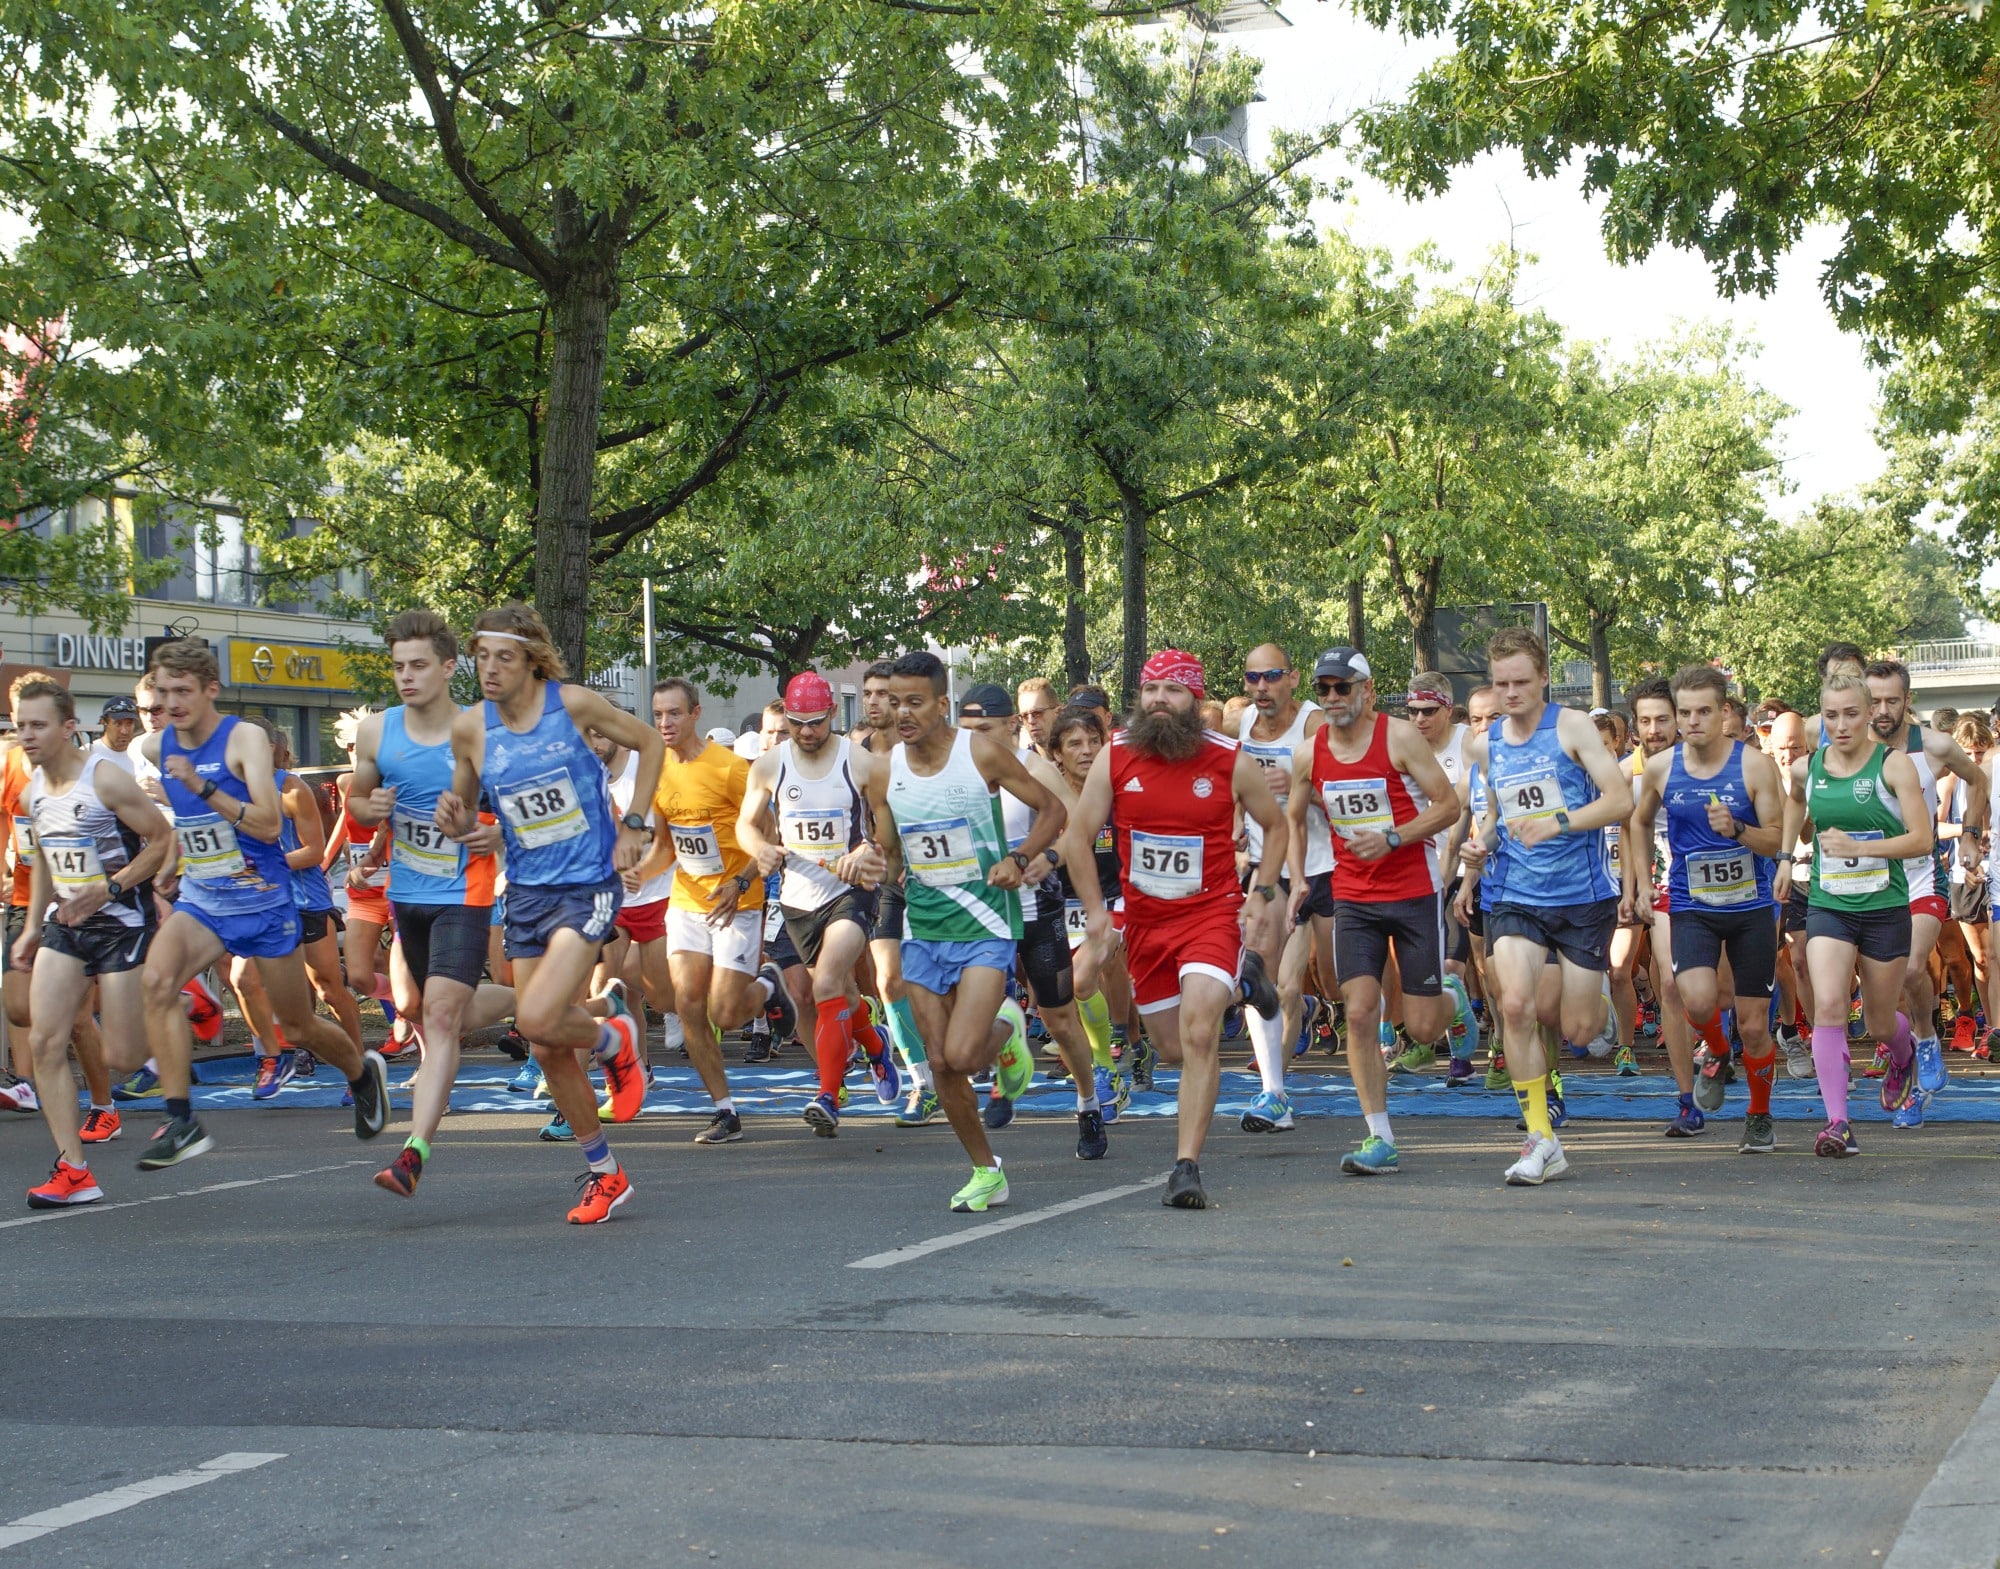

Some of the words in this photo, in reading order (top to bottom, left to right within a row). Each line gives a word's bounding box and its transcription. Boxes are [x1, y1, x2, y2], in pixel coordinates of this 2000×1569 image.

[57, 632, 145, 671] DINNEB
[513, 788, 566, 820] 138
[1334, 793, 1379, 816] 153
[1517, 785, 1545, 810] 49
[183, 828, 223, 854] 151
[403, 820, 446, 850] 157
[794, 821, 836, 842] 154
[675, 835, 709, 855] 290
[921, 834, 951, 859] 31
[52, 851, 86, 873] 147
[1142, 847, 1190, 874] 576
[1699, 860, 1744, 883] 155
